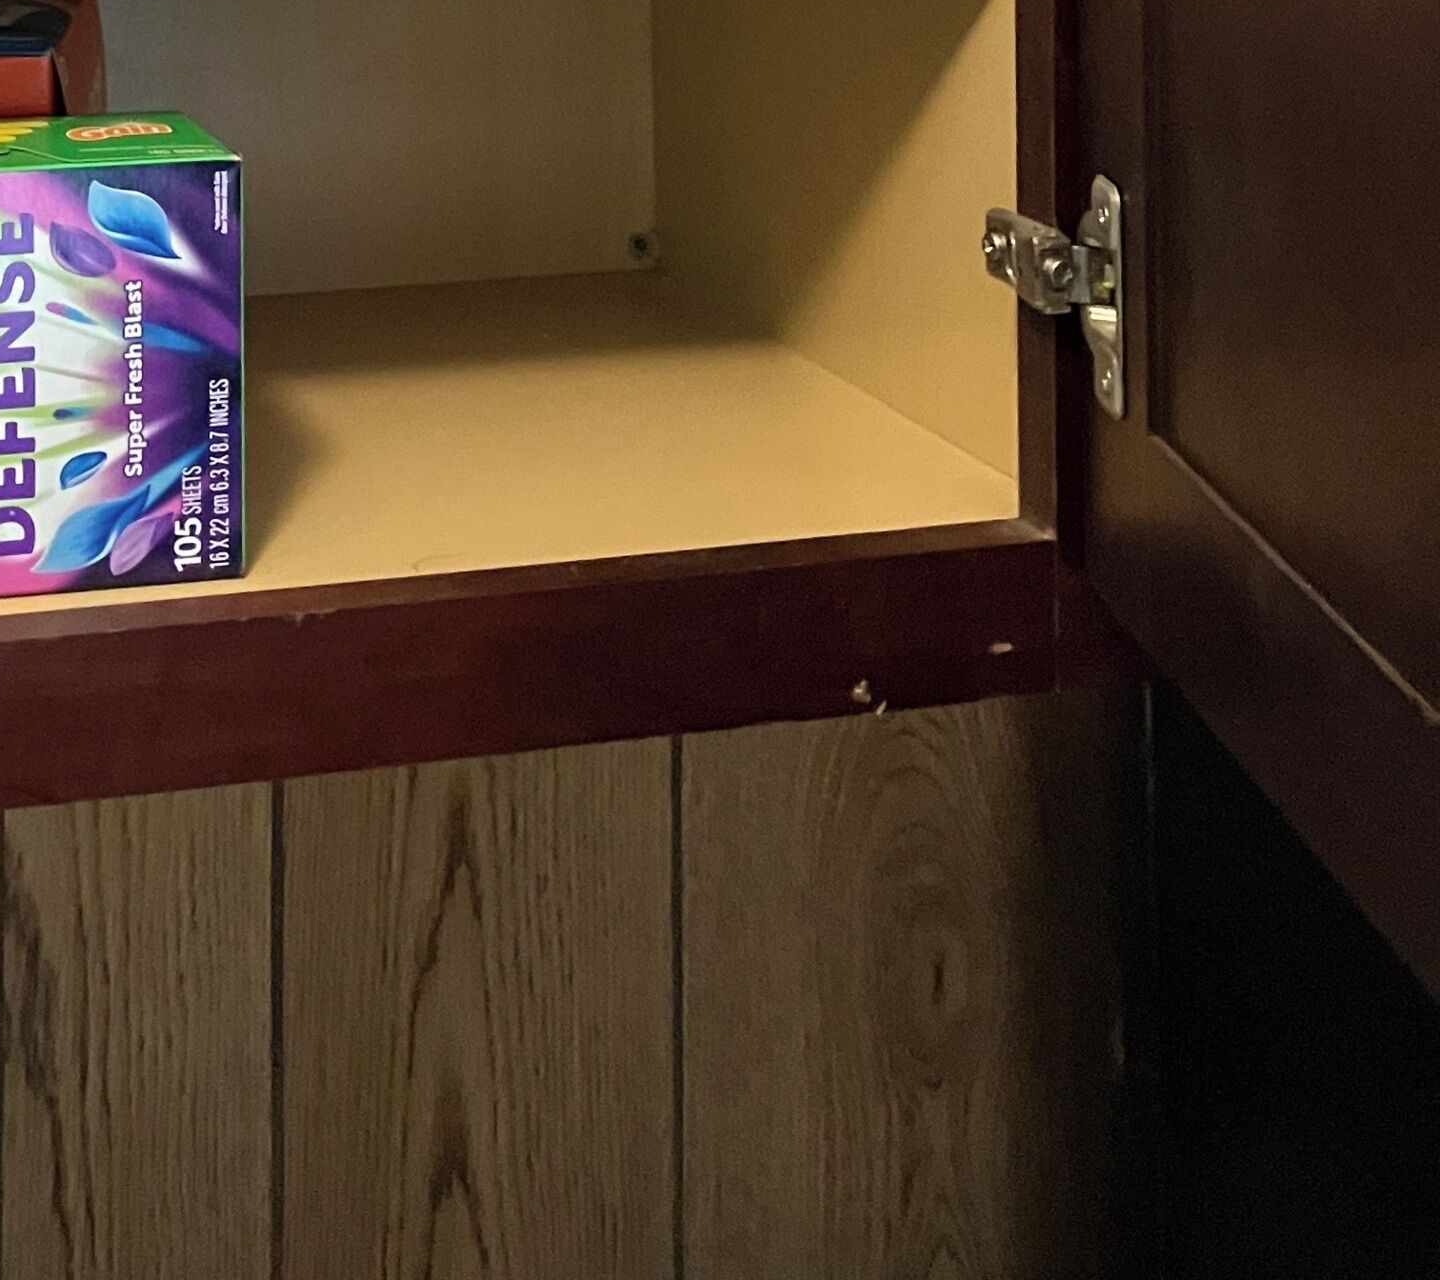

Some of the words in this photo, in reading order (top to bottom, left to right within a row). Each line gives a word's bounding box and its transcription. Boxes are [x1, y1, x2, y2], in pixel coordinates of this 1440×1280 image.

[66, 122, 173, 142] Gain
[124, 281, 143, 340] Blast
[124, 342, 143, 405] Fresh
[210, 378, 230, 427] INCHES
[124, 411, 143, 477] Super
[210, 431, 230, 452] 8.7
[182, 465, 202, 515] SHEETS
[210, 468, 230, 492] 6.3
[213, 493, 230, 514] cm
[210, 517, 230, 535] 22
[174, 517, 202, 572] 105
[210, 551, 230, 568] 16
